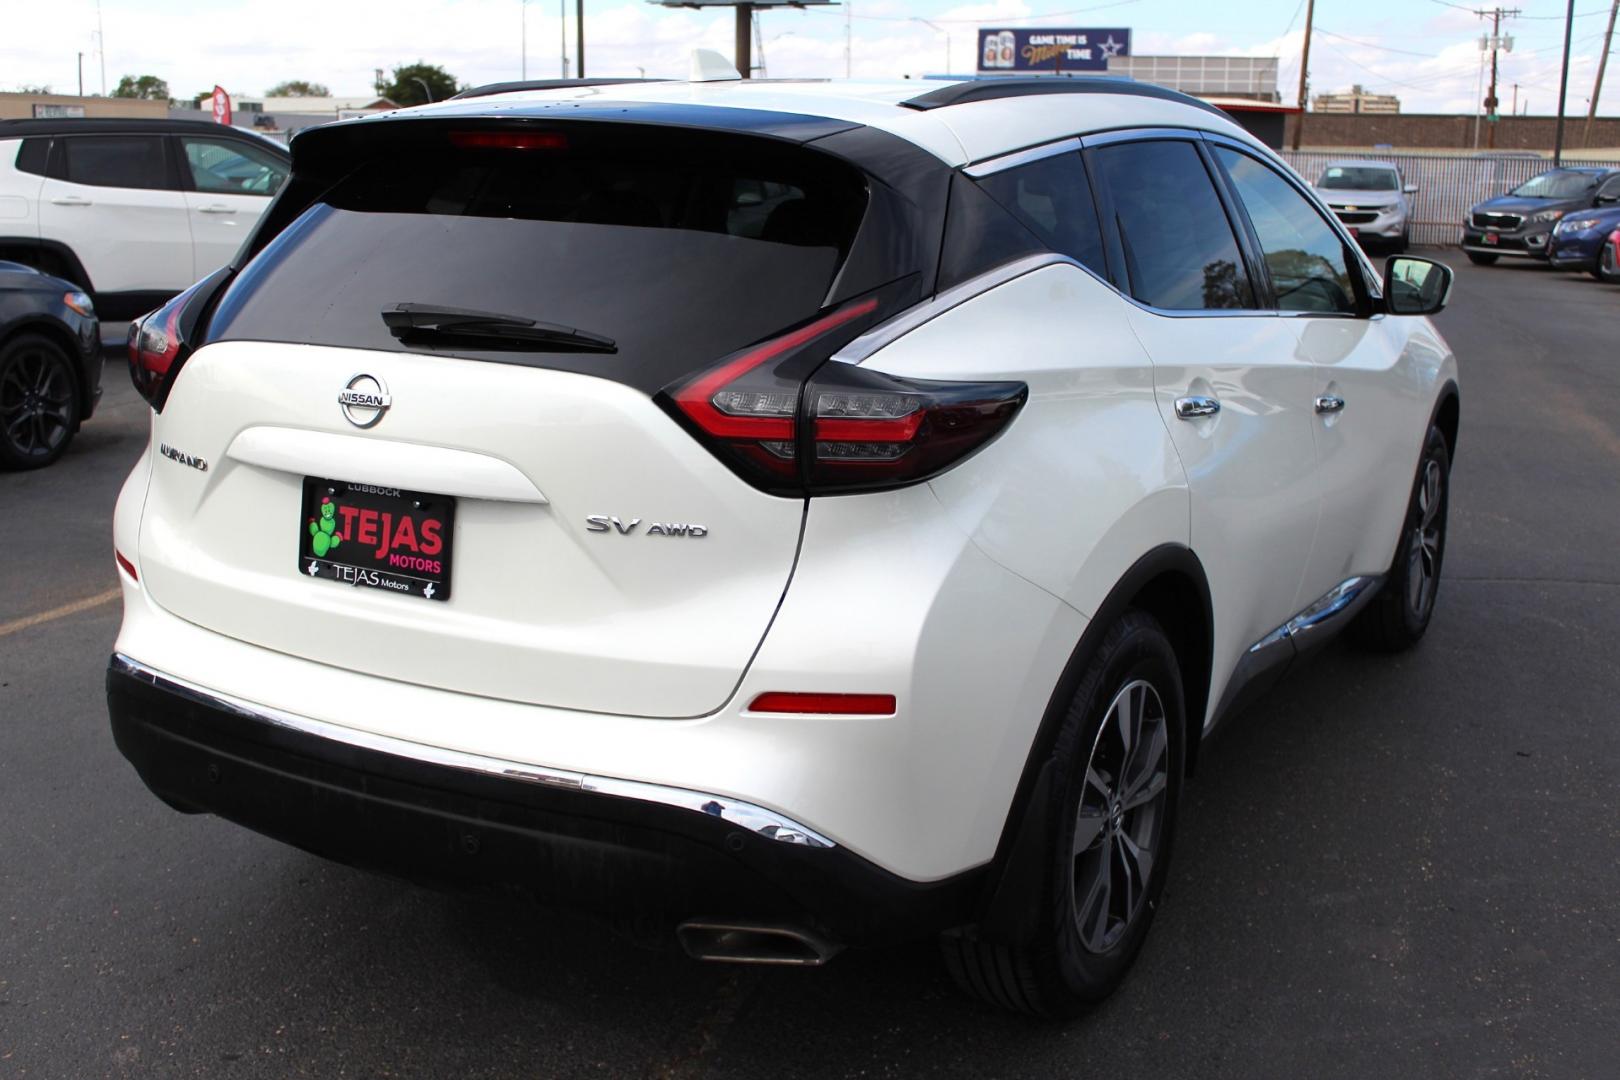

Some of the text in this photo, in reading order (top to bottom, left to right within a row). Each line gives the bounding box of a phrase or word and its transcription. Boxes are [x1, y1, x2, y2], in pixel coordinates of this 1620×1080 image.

[1029, 35, 1087, 45] GAME TIME IS
[1067, 48, 1092, 60] TIME
[341, 392, 383, 405] NISSAN
[348, 484, 400, 497] LUBBOCK
[339, 505, 443, 559] TEJAS
[586, 514, 708, 537] SV AWD
[389, 554, 441, 574] MOTORS
[333, 564, 409, 591] TEJAS Motors
